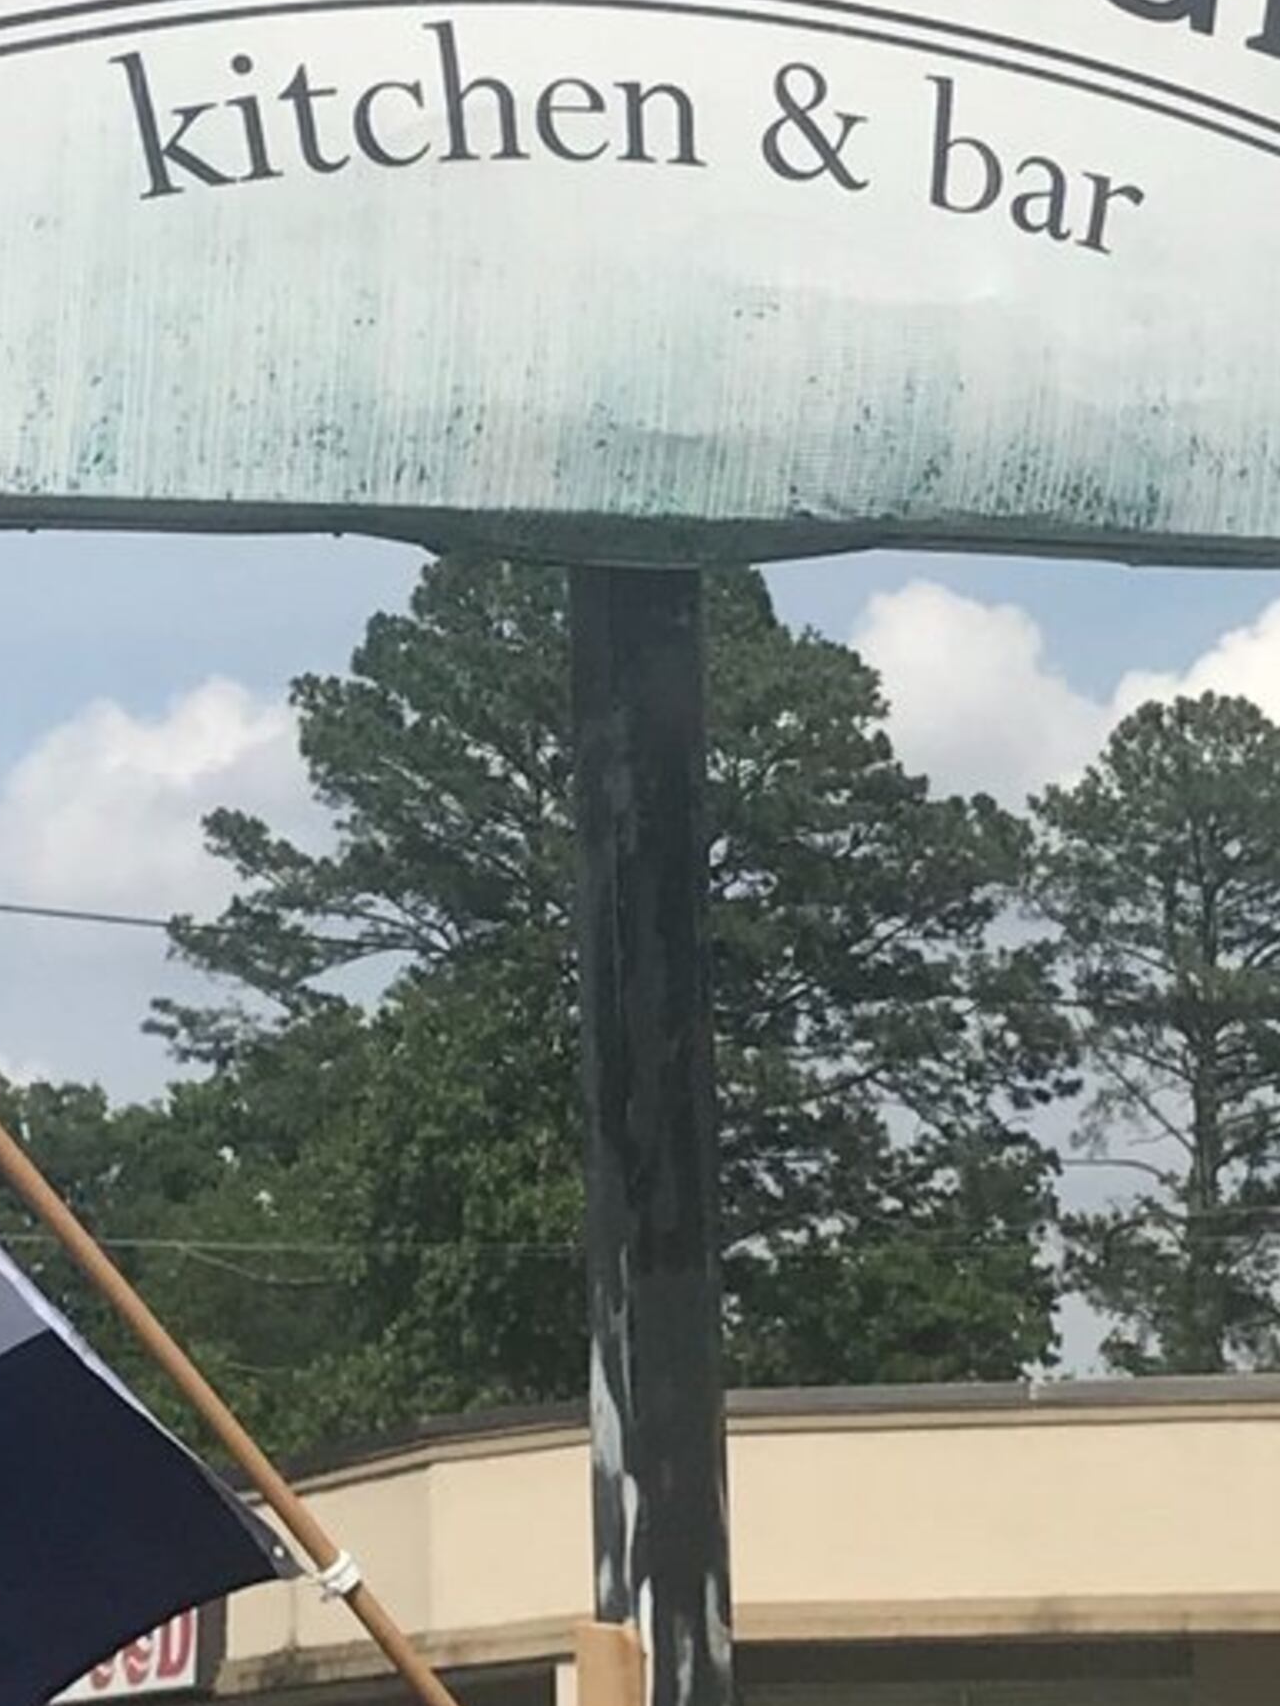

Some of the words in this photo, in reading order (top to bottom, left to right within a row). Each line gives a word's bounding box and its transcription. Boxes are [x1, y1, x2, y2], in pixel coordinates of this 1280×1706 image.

[119, 20, 706, 201] kitchen
[760, 63, 868, 191] &
[927, 76, 1145, 255] bar
